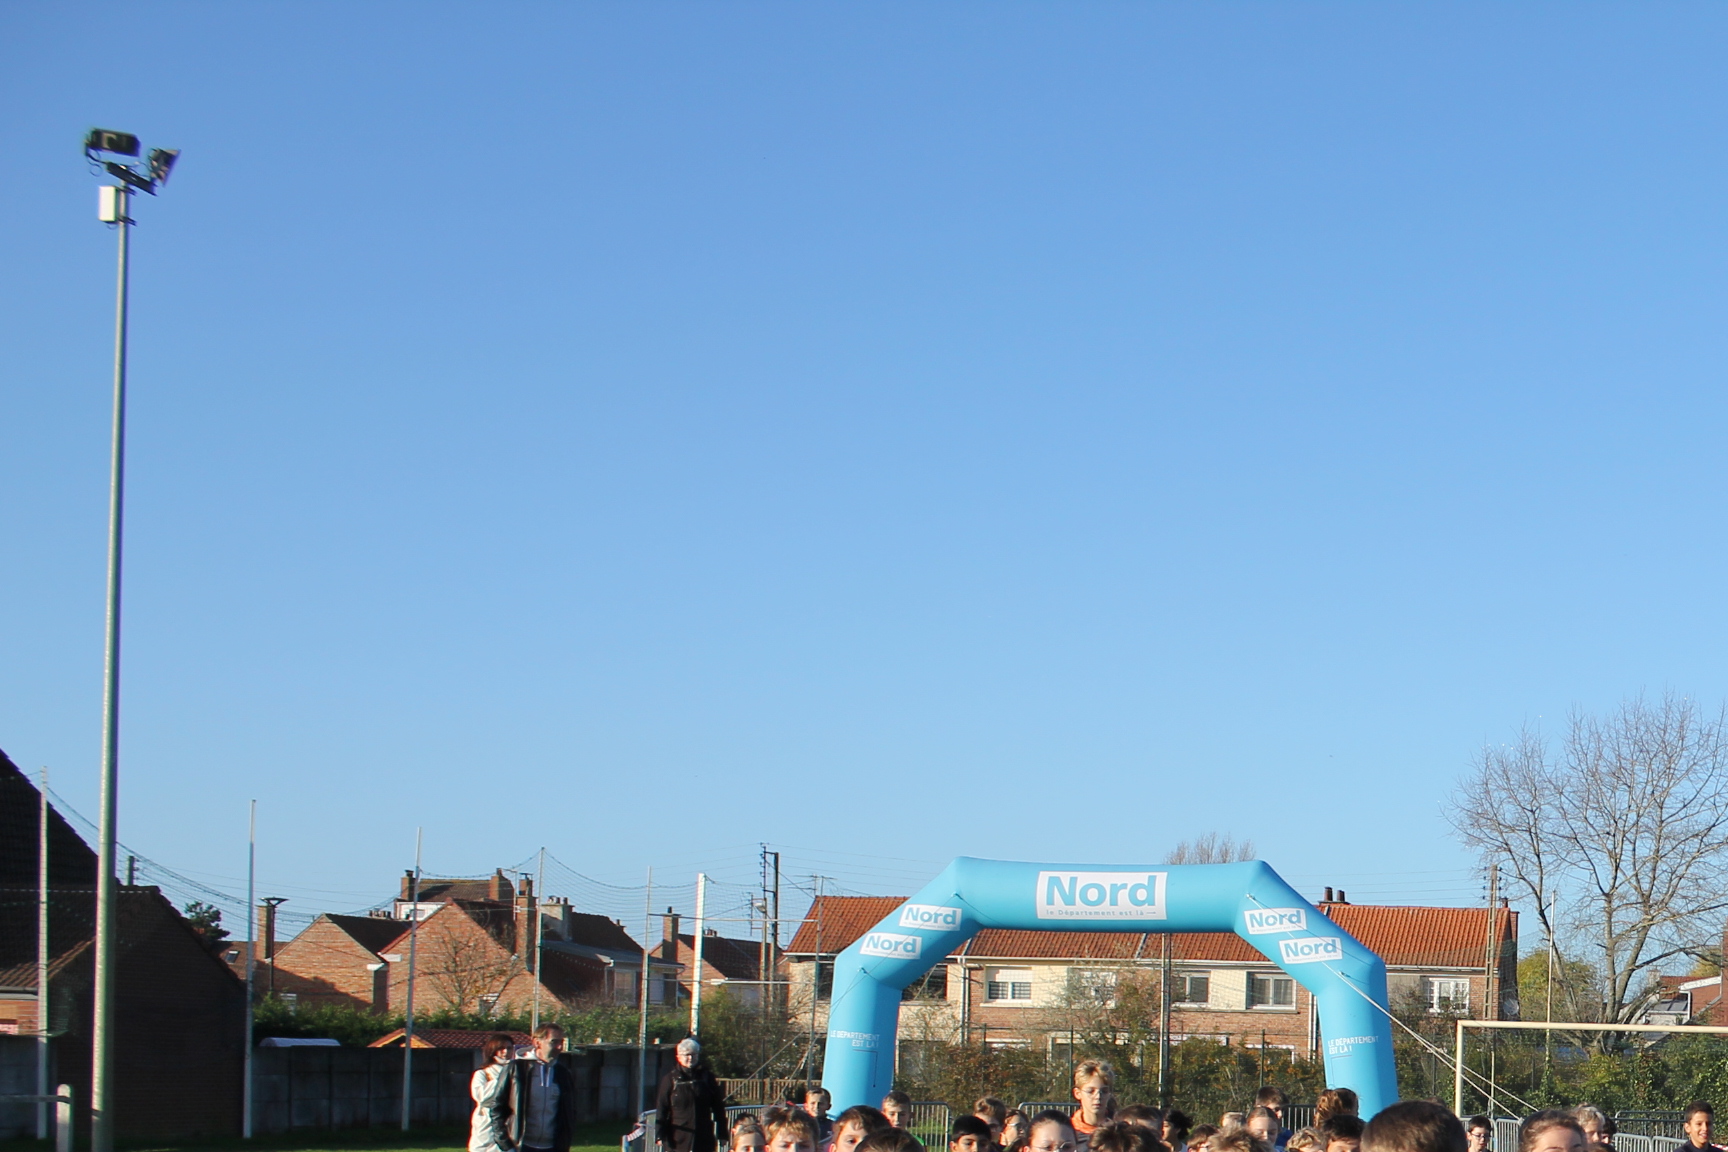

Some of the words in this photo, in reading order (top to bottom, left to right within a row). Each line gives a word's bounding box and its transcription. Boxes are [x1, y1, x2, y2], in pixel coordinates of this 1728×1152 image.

[1046, 875, 1157, 907] Nord
[905, 907, 957, 925] Nord
[1058, 909, 1115, 917] Département
[1249, 910, 1301, 928] Nord
[865, 935, 917, 953] Nord
[1284, 939, 1337, 958] Nord
